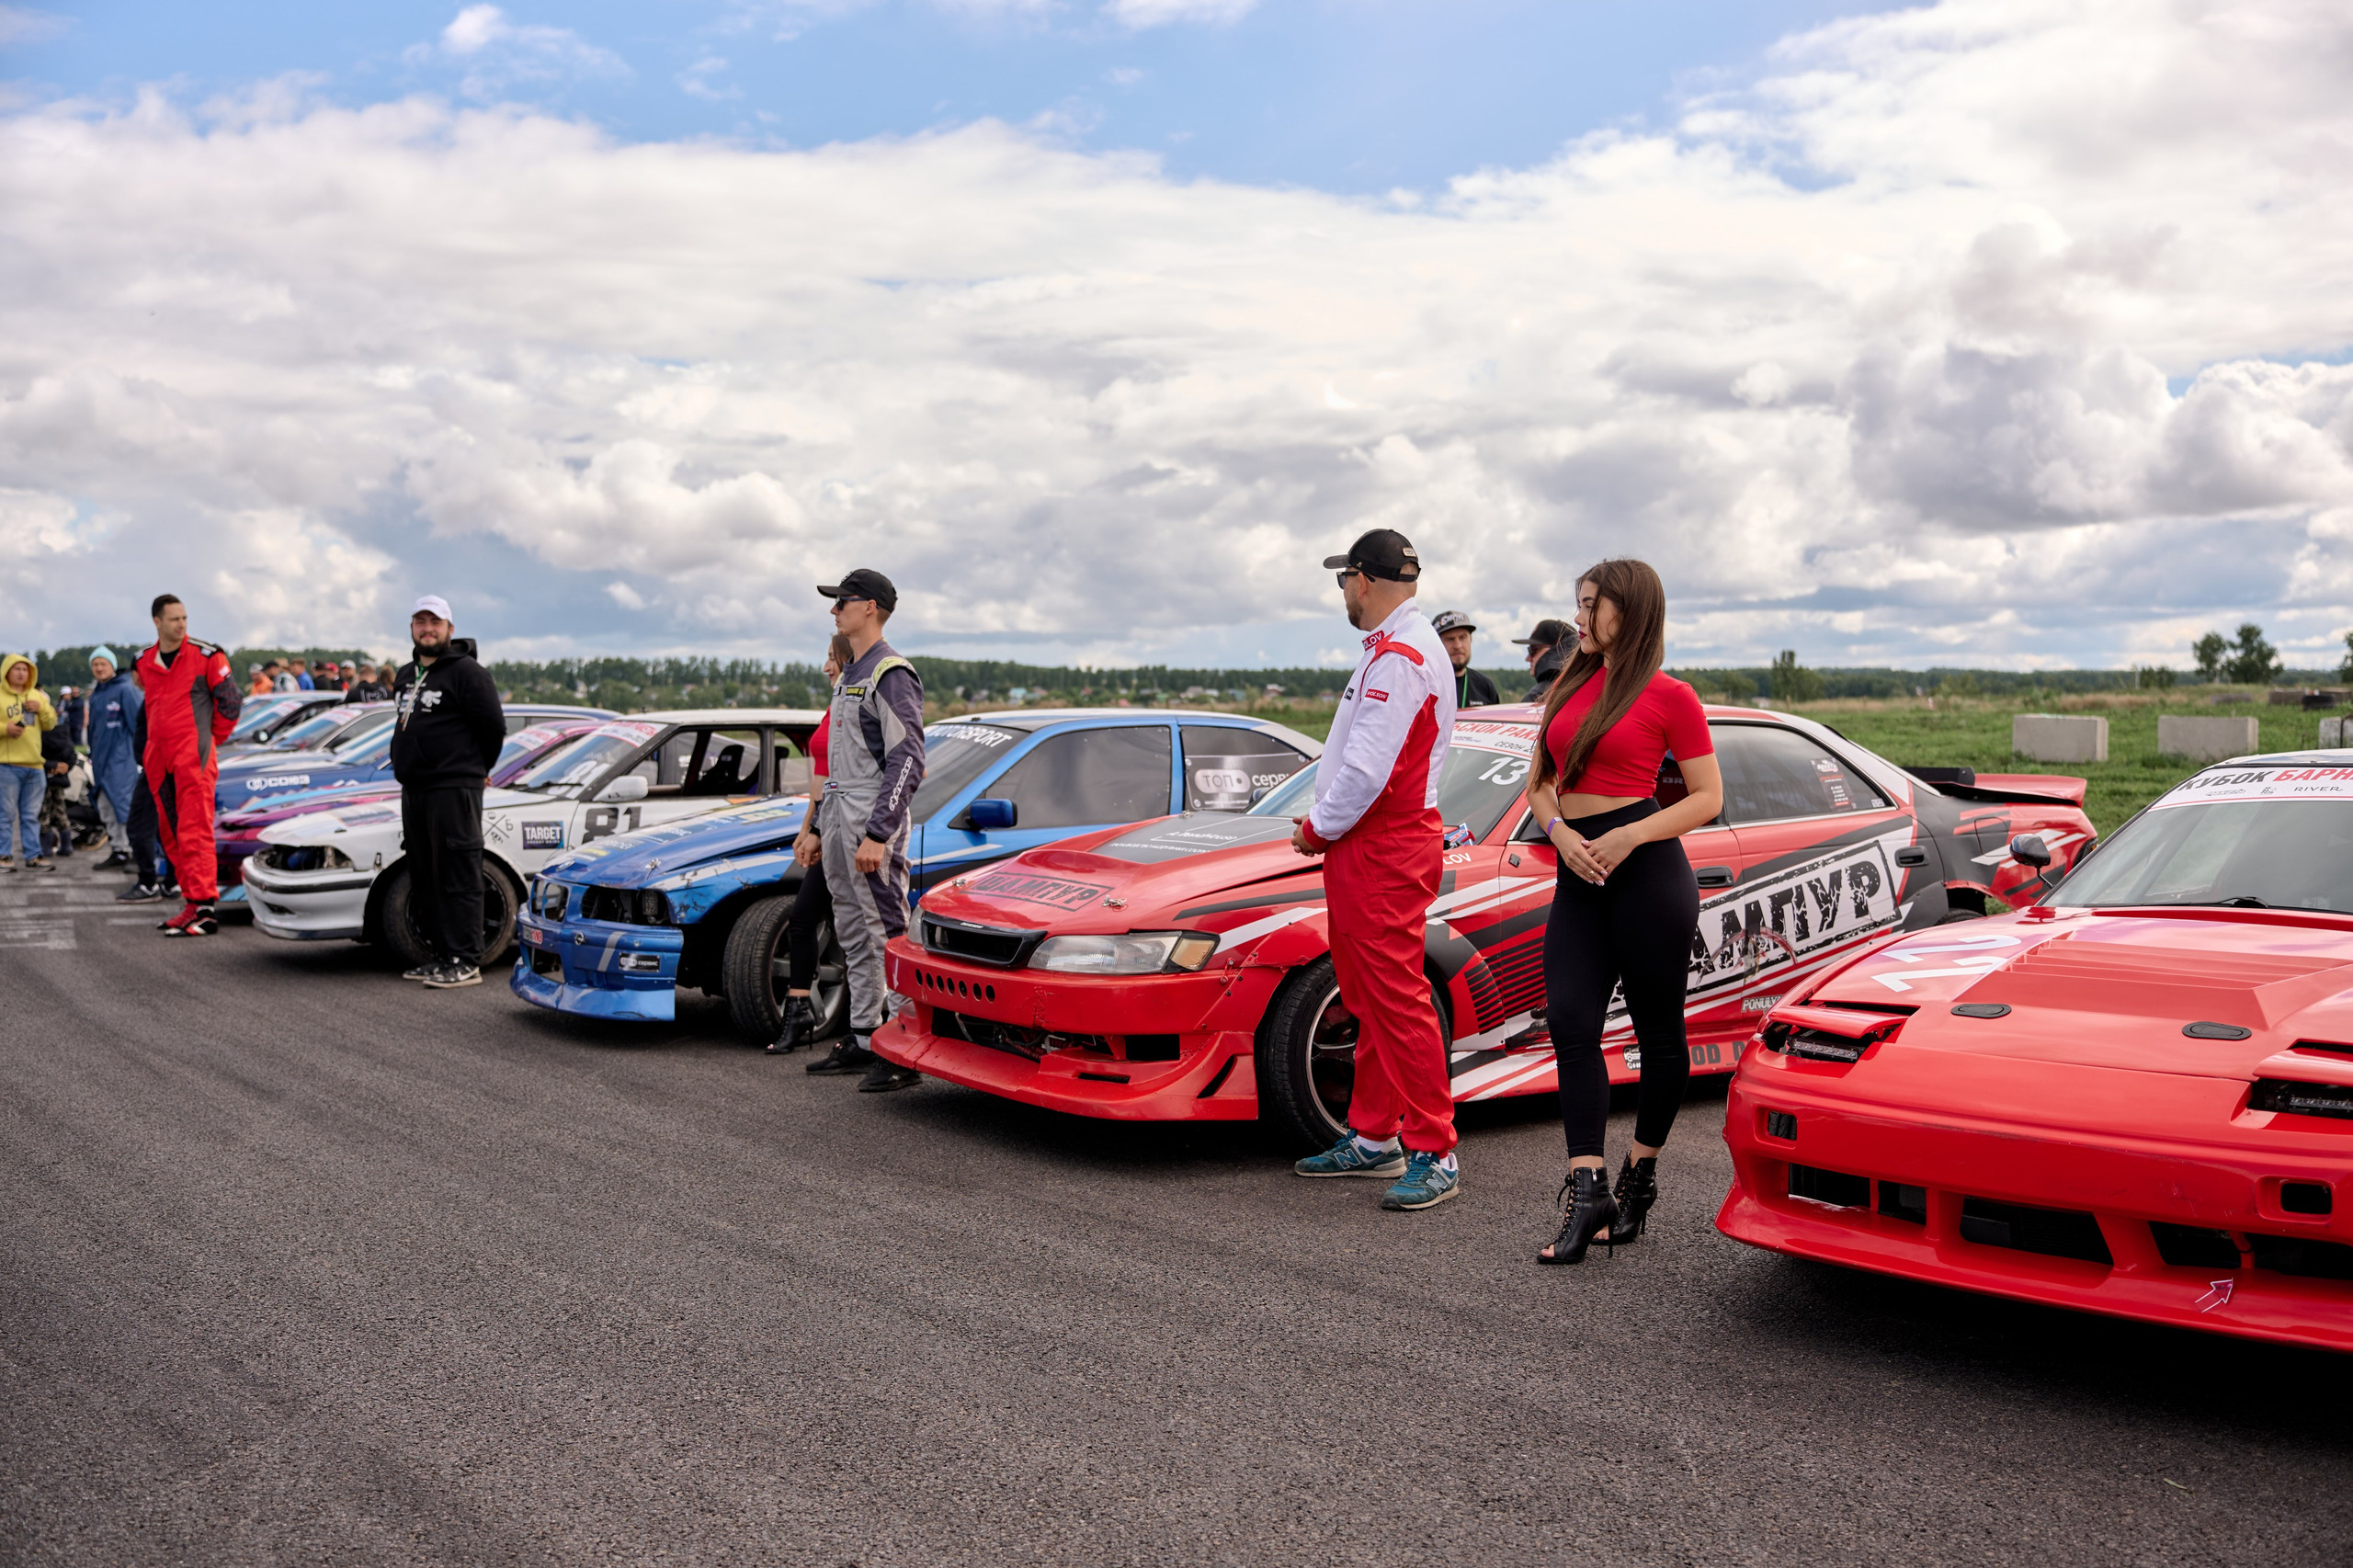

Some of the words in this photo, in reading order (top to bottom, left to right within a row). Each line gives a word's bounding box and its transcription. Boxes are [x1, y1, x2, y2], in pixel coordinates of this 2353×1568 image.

[1202, 774, 1233, 788] ТОП
[1478, 756, 1531, 786] 13
[2177, 770, 2276, 791] КУБОК
[2293, 785, 2343, 793] RIVER
[525, 826, 561, 840] TARGET
[581, 806, 642, 845] 81
[1686, 860, 1881, 974] АМПУР
[1334, 1149, 1361, 1170] N
